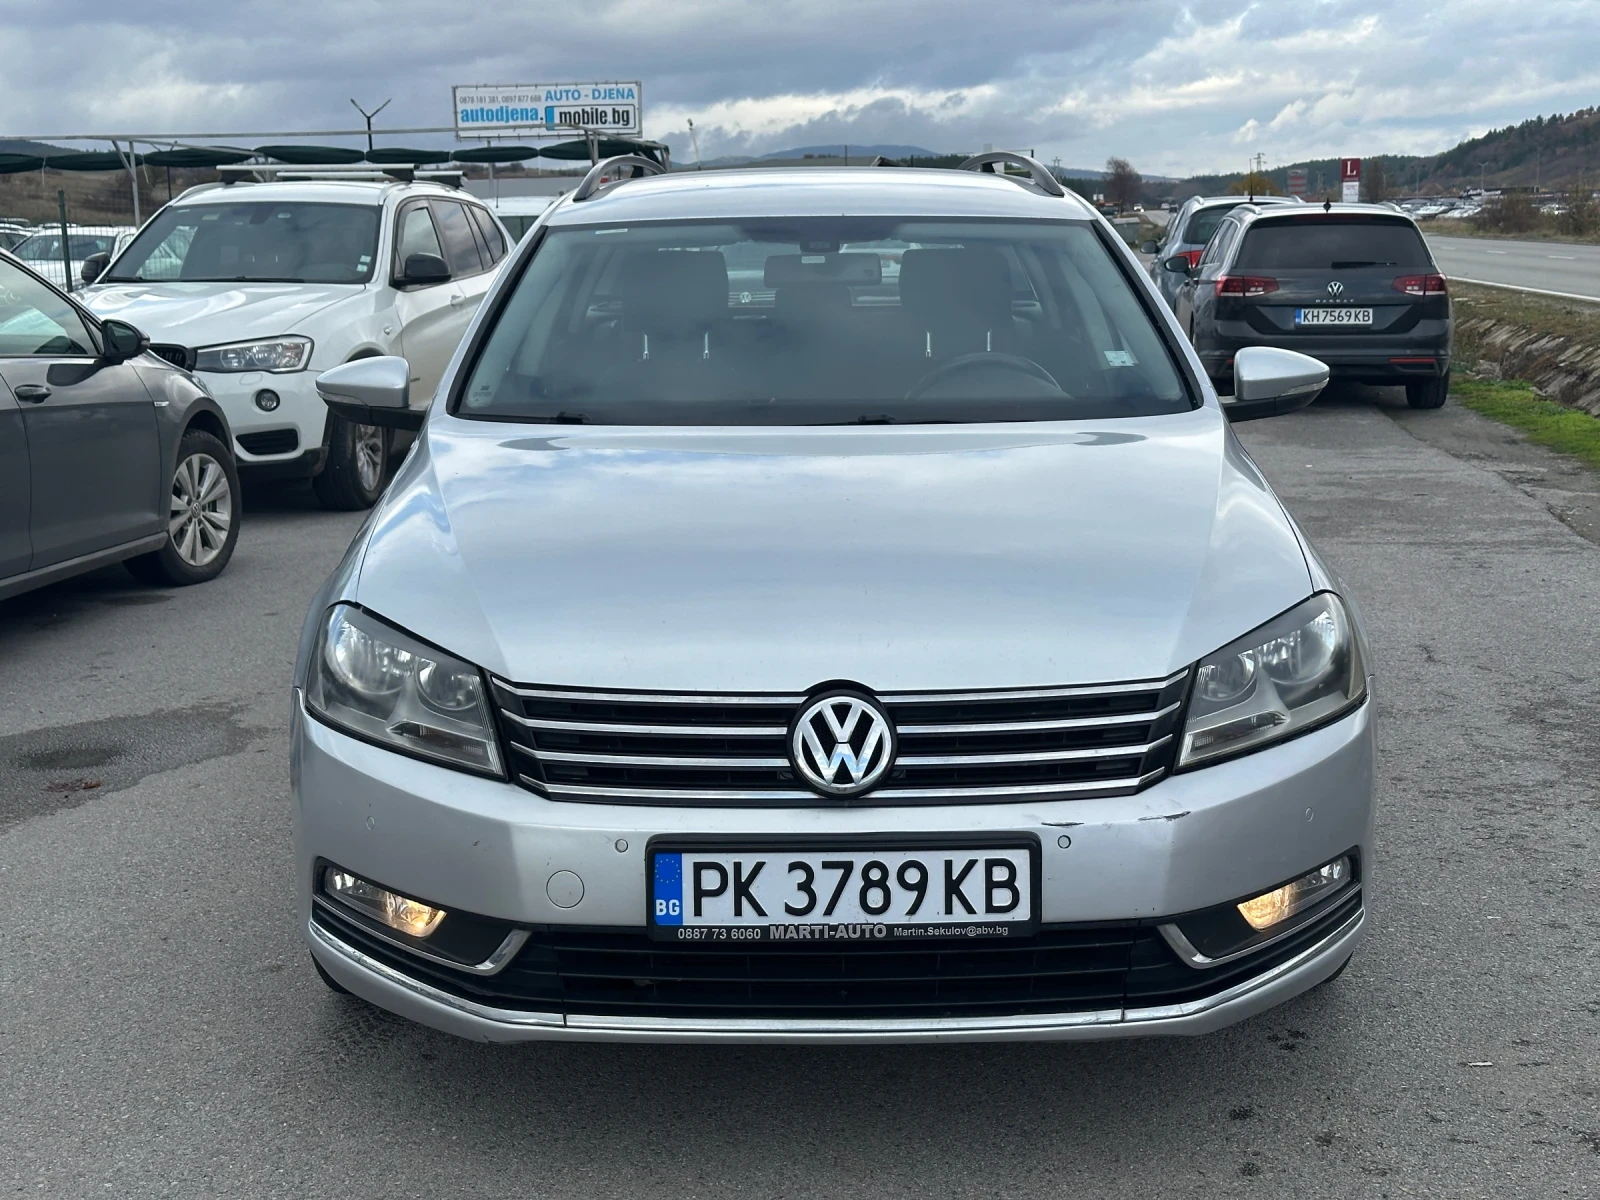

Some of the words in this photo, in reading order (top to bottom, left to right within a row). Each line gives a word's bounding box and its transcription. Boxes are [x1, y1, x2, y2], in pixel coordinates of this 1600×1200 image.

[545, 89, 581, 101] AUTO
[592, 88, 635, 100] DJENA
[559, 107, 630, 126] mobile.bg
[1347, 161, 1357, 176] L
[692, 861, 769, 917] PK
[784, 859, 929, 917] 3789
[943, 857, 1021, 916] KB
[655, 899, 681, 916] BG
[677, 928, 708, 940] 0887
[711, 928, 727, 940] 73
[730, 928, 761, 940] 6060
[769, 924, 887, 940] MARTI-AUTO
[893, 925, 1009, 938] Martin.Sekulov@abv.bg
